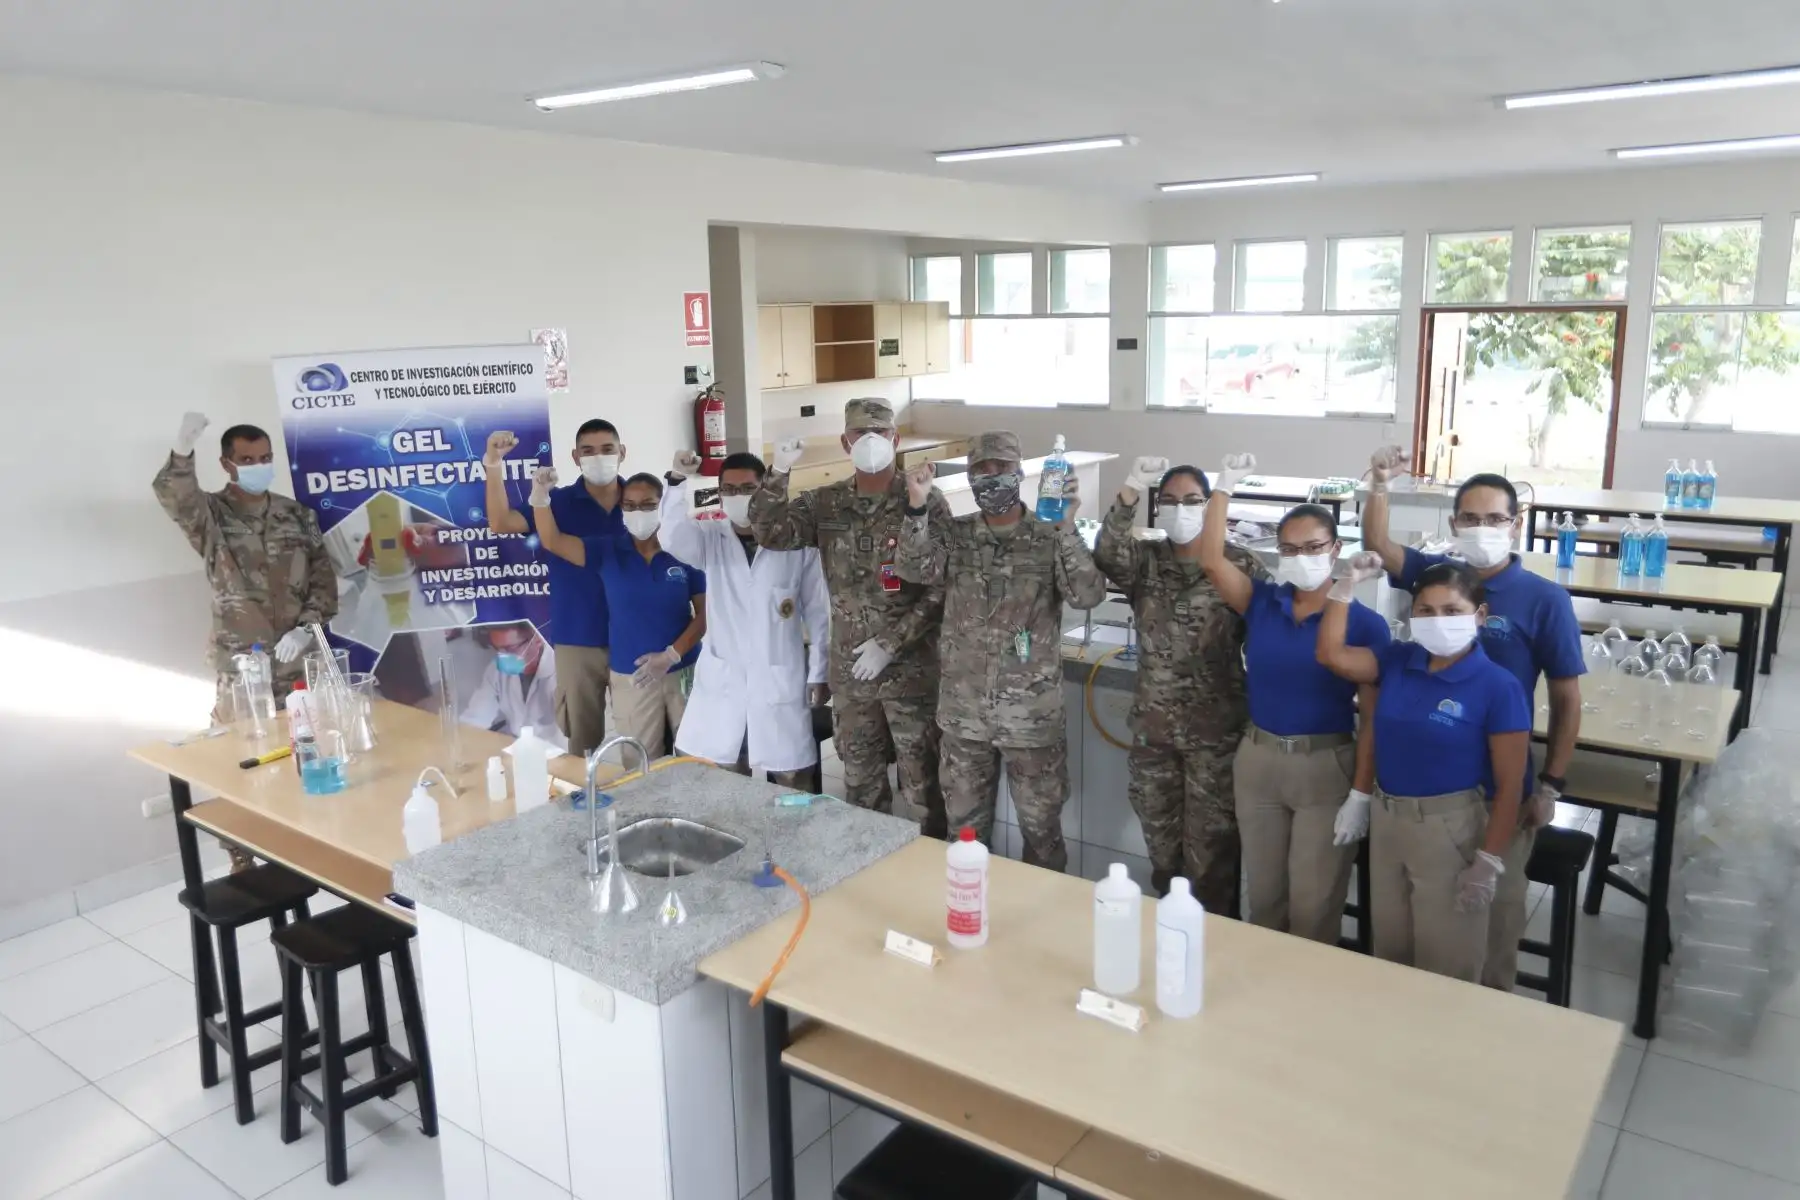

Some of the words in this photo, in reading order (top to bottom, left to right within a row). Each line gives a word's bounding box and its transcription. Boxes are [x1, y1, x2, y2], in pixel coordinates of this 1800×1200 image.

[350, 369, 389, 383] CENTRO
[391, 369, 405, 381] DE
[406, 362, 480, 380] INVESTIGACIÓN
[482, 360, 534, 377] CIENTÍFICO
[374, 388, 382, 400] Y
[383, 382, 451, 400] TECNOLÓGICO
[453, 384, 471, 396] DEL
[473, 379, 517, 395] EJÉRCITO
[291, 393, 356, 410] CICTE
[392, 429, 452, 454] GEL
[306, 458, 540, 495] DESINFECTATE
[475, 546, 499, 560] DE
[424, 590, 437, 603] Y
